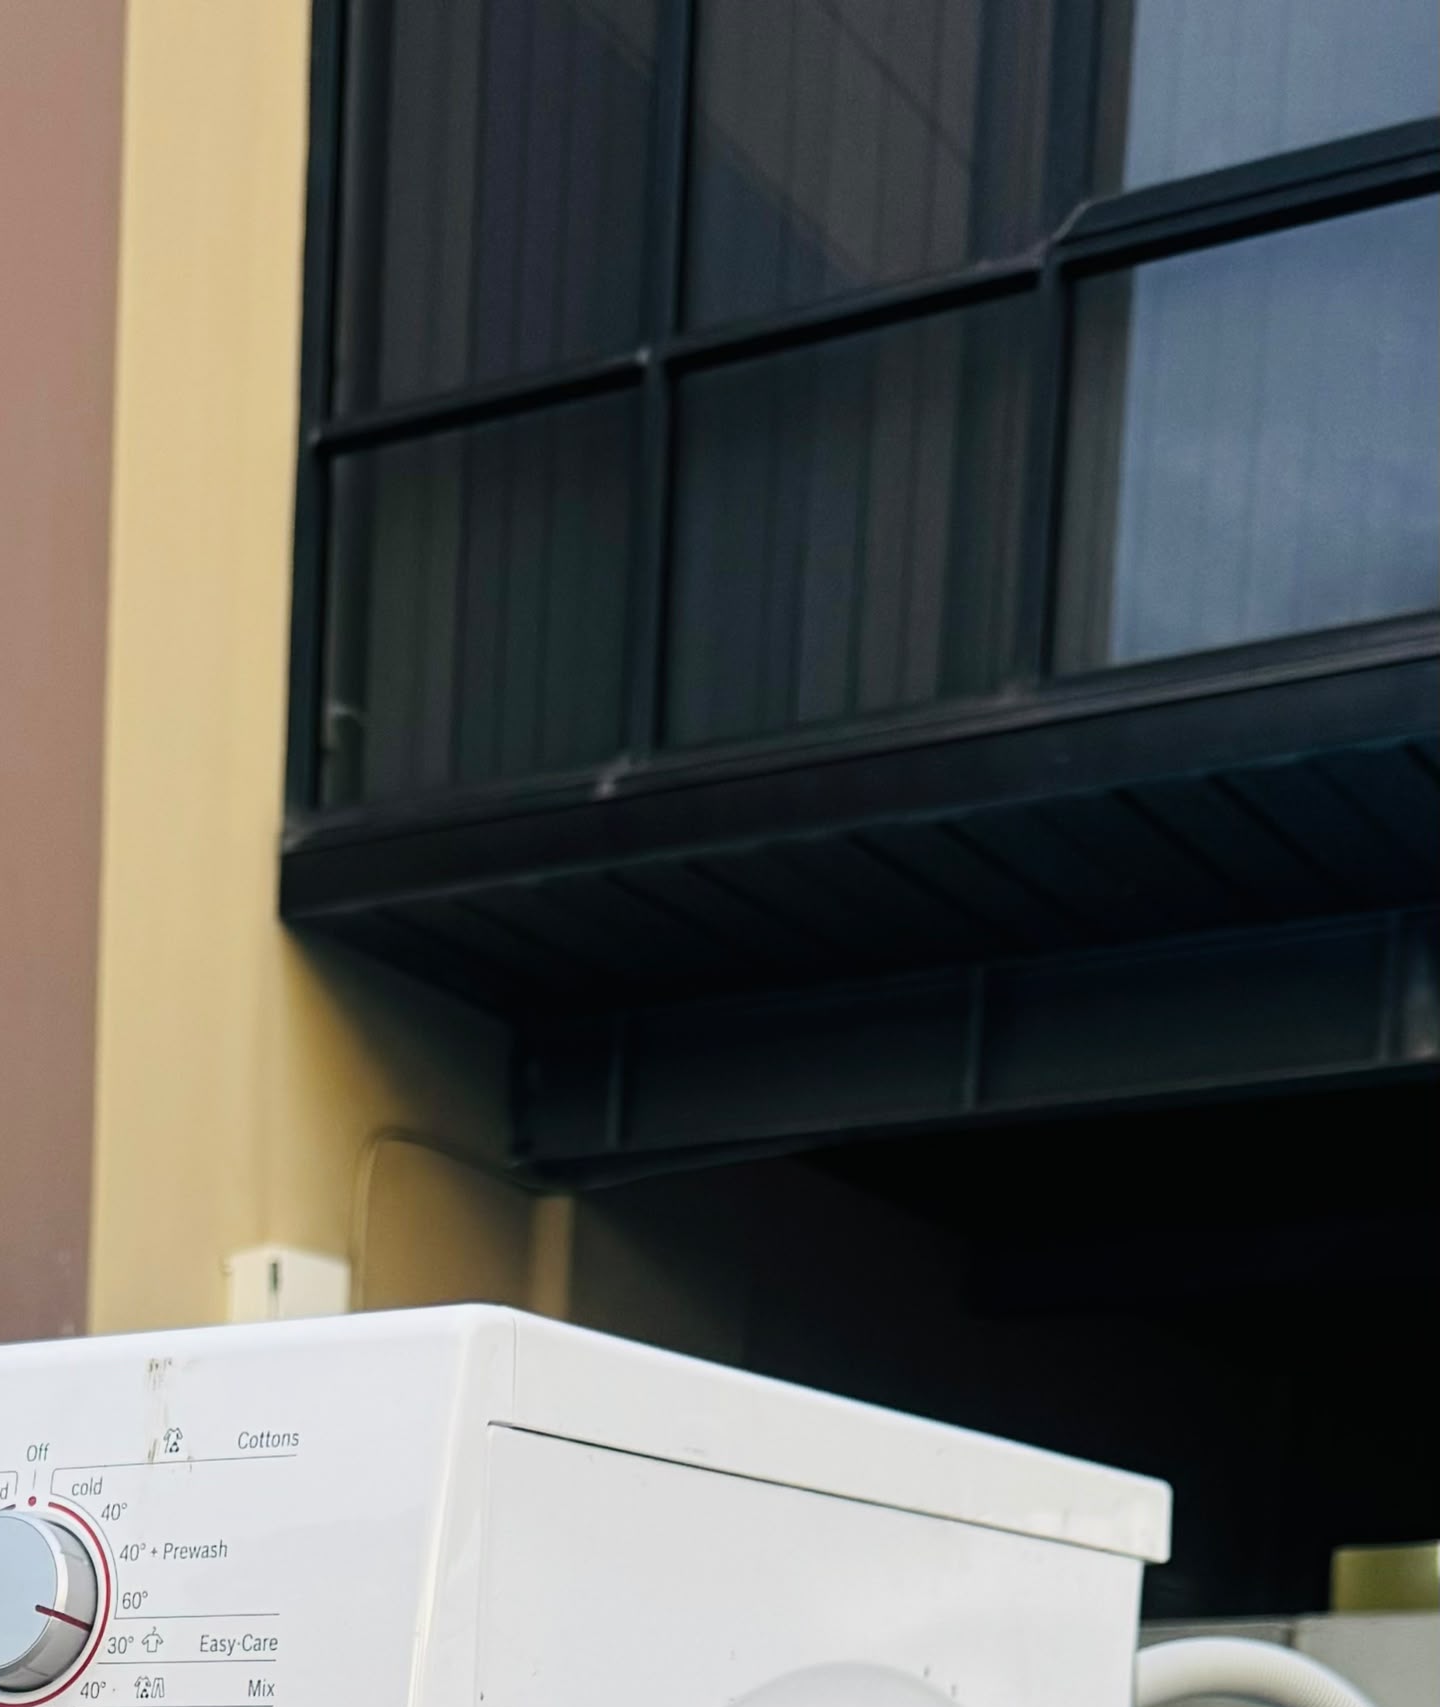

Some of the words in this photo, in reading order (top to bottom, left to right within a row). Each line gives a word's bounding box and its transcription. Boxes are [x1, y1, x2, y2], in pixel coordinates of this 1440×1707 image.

[237, 1430, 300, 1450] Cottons
[26, 1443, 49, 1462] Off
[71, 1477, 103, 1497] cold
[101, 1502, 128, 1521] 40°
[119, 1543, 146, 1562] 40°
[162, 1540, 228, 1561] Prewash
[122, 1591, 148, 1610] 60°
[107, 1635, 134, 1655] 30°
[80, 1681, 106, 1699] 40°
[248, 1678, 276, 1698] Mix
